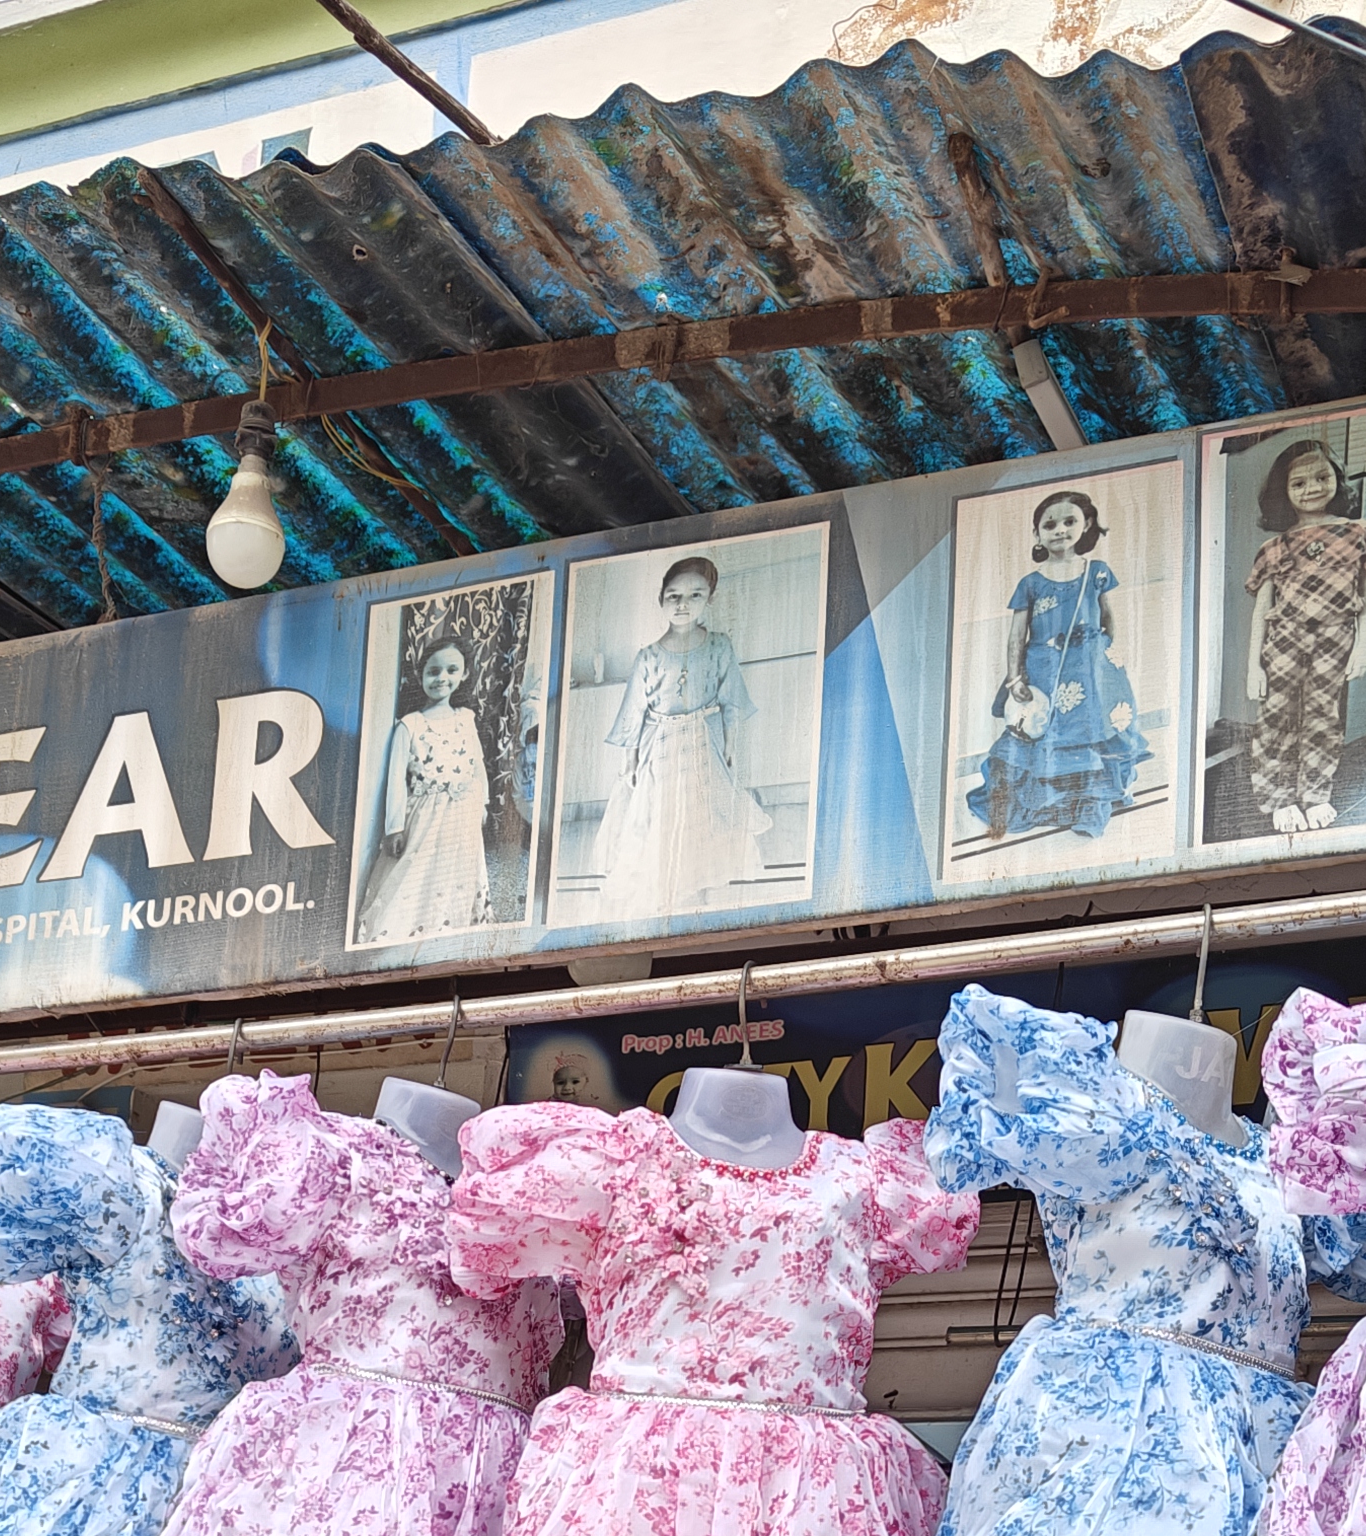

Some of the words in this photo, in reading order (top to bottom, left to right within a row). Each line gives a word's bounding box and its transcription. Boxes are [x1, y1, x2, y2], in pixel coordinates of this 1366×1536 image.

[120, 882, 317, 933] KURNOOL.
[621, 1034, 673, 1055] Prop
[686, 1028, 710, 1047] H.
[1175, 1046, 1227, 1087] JA
